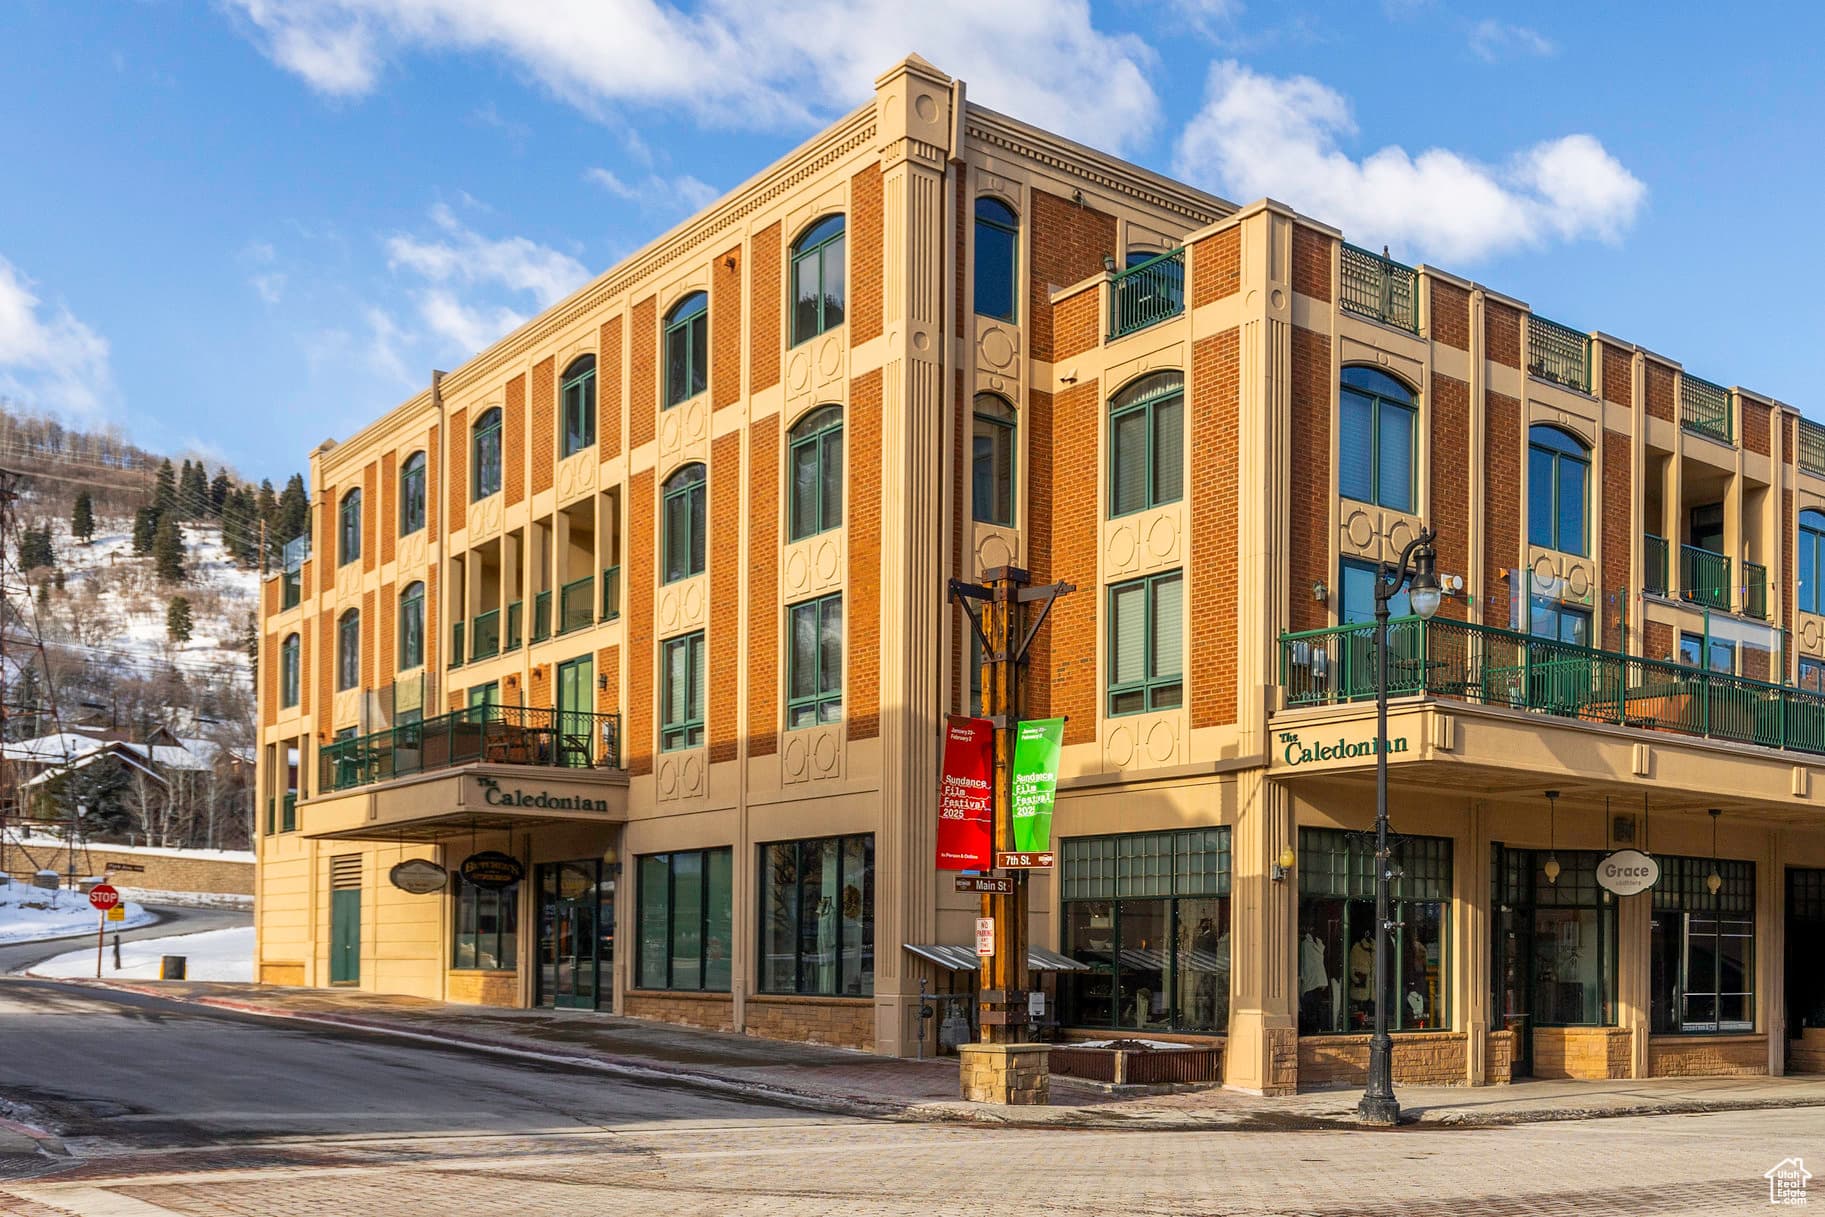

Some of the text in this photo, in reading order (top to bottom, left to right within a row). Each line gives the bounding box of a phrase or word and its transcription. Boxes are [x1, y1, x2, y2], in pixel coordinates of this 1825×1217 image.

[950, 733, 969, 742] February
[1279, 732, 1298, 743] The
[477, 777, 497, 787] The
[945, 774, 987, 787] Sundance
[1016, 772, 1054, 783] Sundance
[945, 785, 966, 796] Film
[1016, 784, 1037, 793] Film
[485, 787, 608, 812] Caledonian
[944, 797, 986, 809] Festival
[943, 808, 964, 818] 2025
[1005, 855, 1018, 865] 7th
[1020, 855, 1031, 865] St.
[1605, 864, 1649, 878] Grace
[976, 880, 995, 891] Main
[997, 881, 1006, 891] St
[90, 891, 117, 903] STOP
[981, 921, 988, 929] NO
